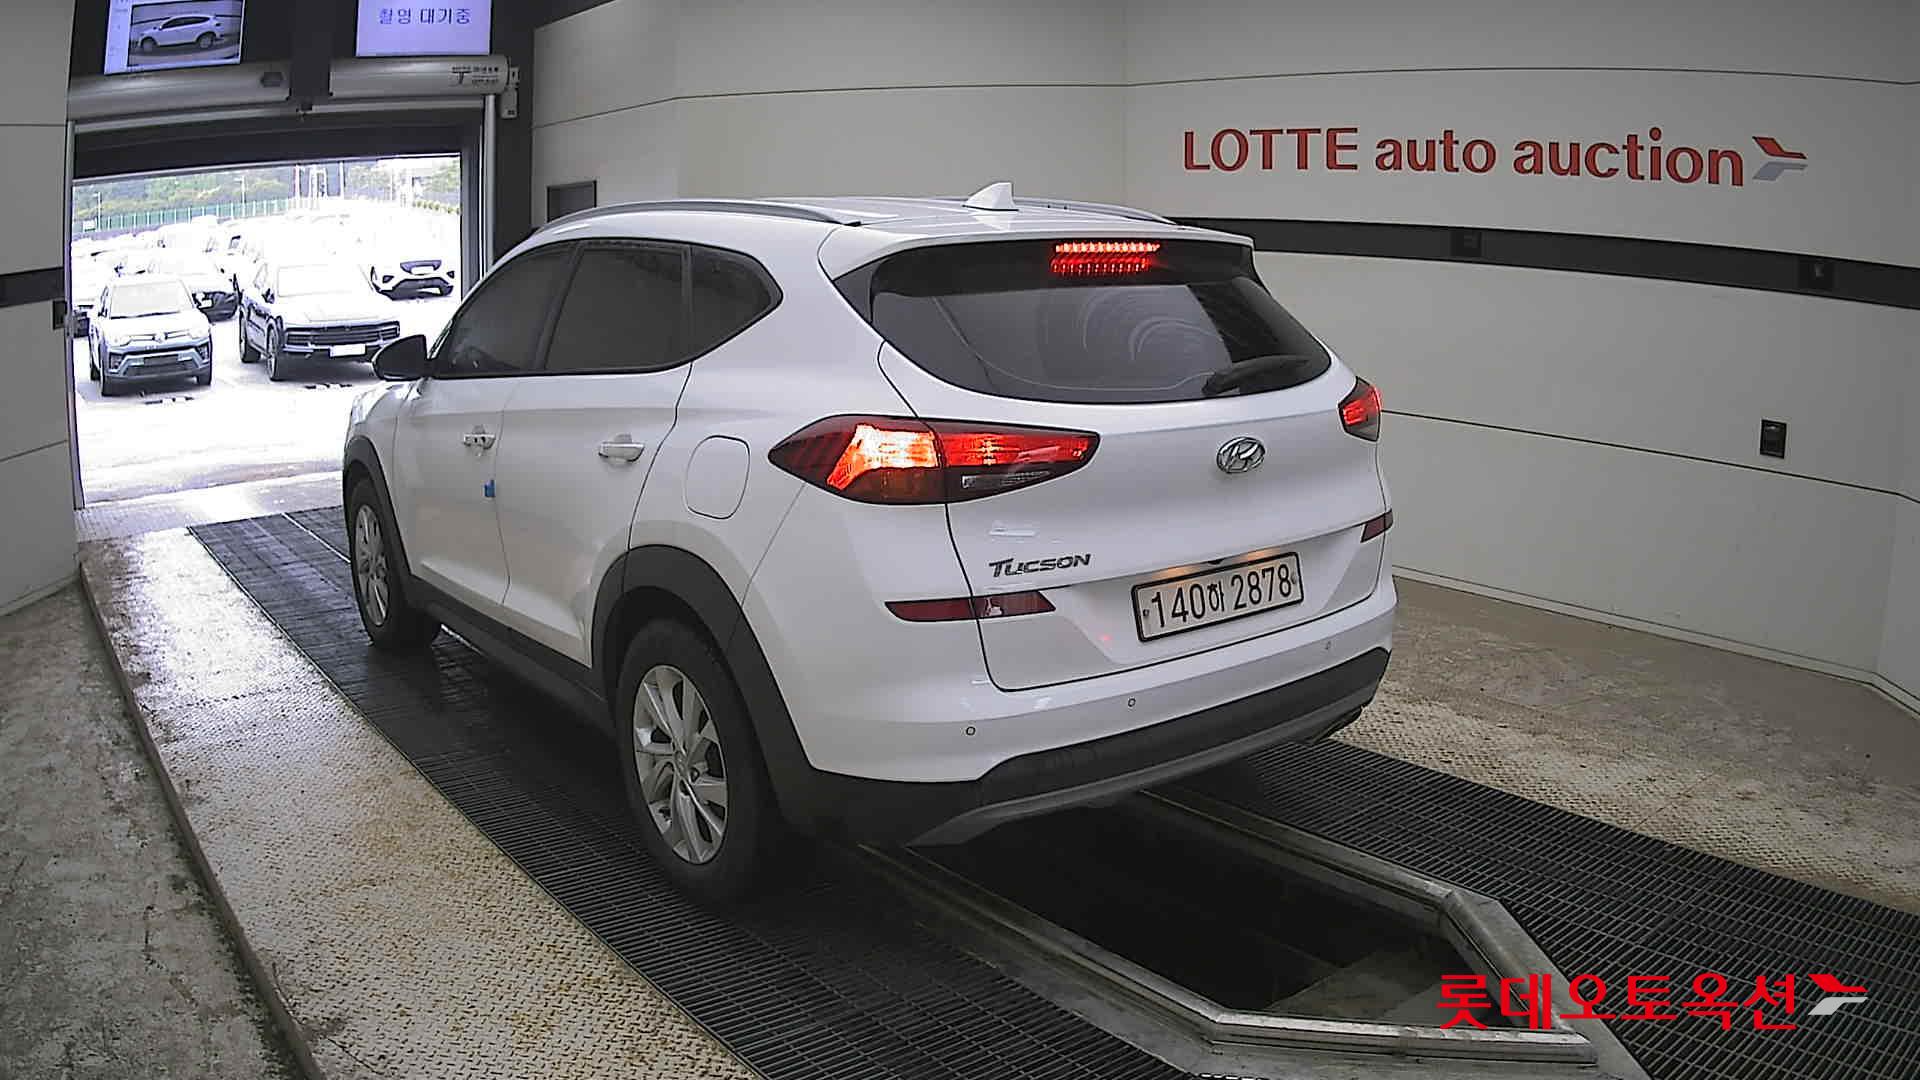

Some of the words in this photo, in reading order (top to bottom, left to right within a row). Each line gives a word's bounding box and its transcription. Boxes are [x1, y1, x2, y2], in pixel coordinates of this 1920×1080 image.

[420, 8, 472, 24] 대기중
[1184, 128, 1359, 171] LOTTE
[1375, 131, 1497, 172] auto
[1513, 127, 1743, 187] auction
